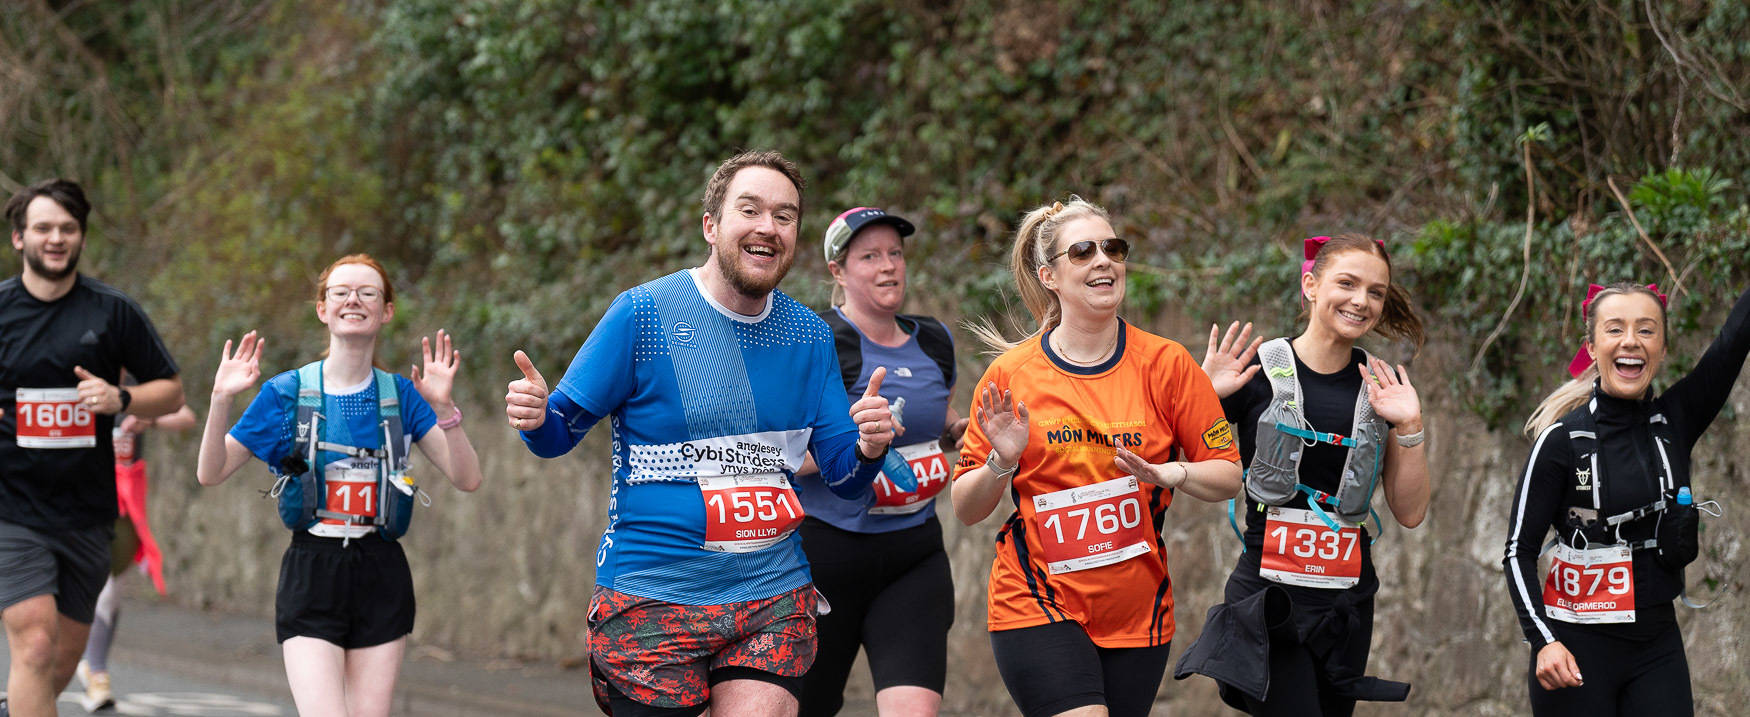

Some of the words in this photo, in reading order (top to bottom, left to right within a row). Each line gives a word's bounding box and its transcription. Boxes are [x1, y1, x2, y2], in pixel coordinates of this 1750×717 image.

[19, 403, 91, 427] 1606
[1047, 425, 1083, 445] MÔN
[736, 441, 782, 457] anglesey
[720, 463, 749, 475] ynys
[873, 457, 948, 497] 144
[326, 484, 372, 512] 11
[708, 491, 796, 524] 1551
[736, 528, 756, 538] SION
[757, 526, 778, 537] LLYR
[1043, 498, 1141, 544] 1760
[1087, 541, 1113, 553] SOFIE
[1271, 525, 1358, 561] 1337
[1304, 564, 1326, 574] ERIN
[1550, 561, 1631, 597] 1879
[1572, 601, 1617, 611] ORMEROD
